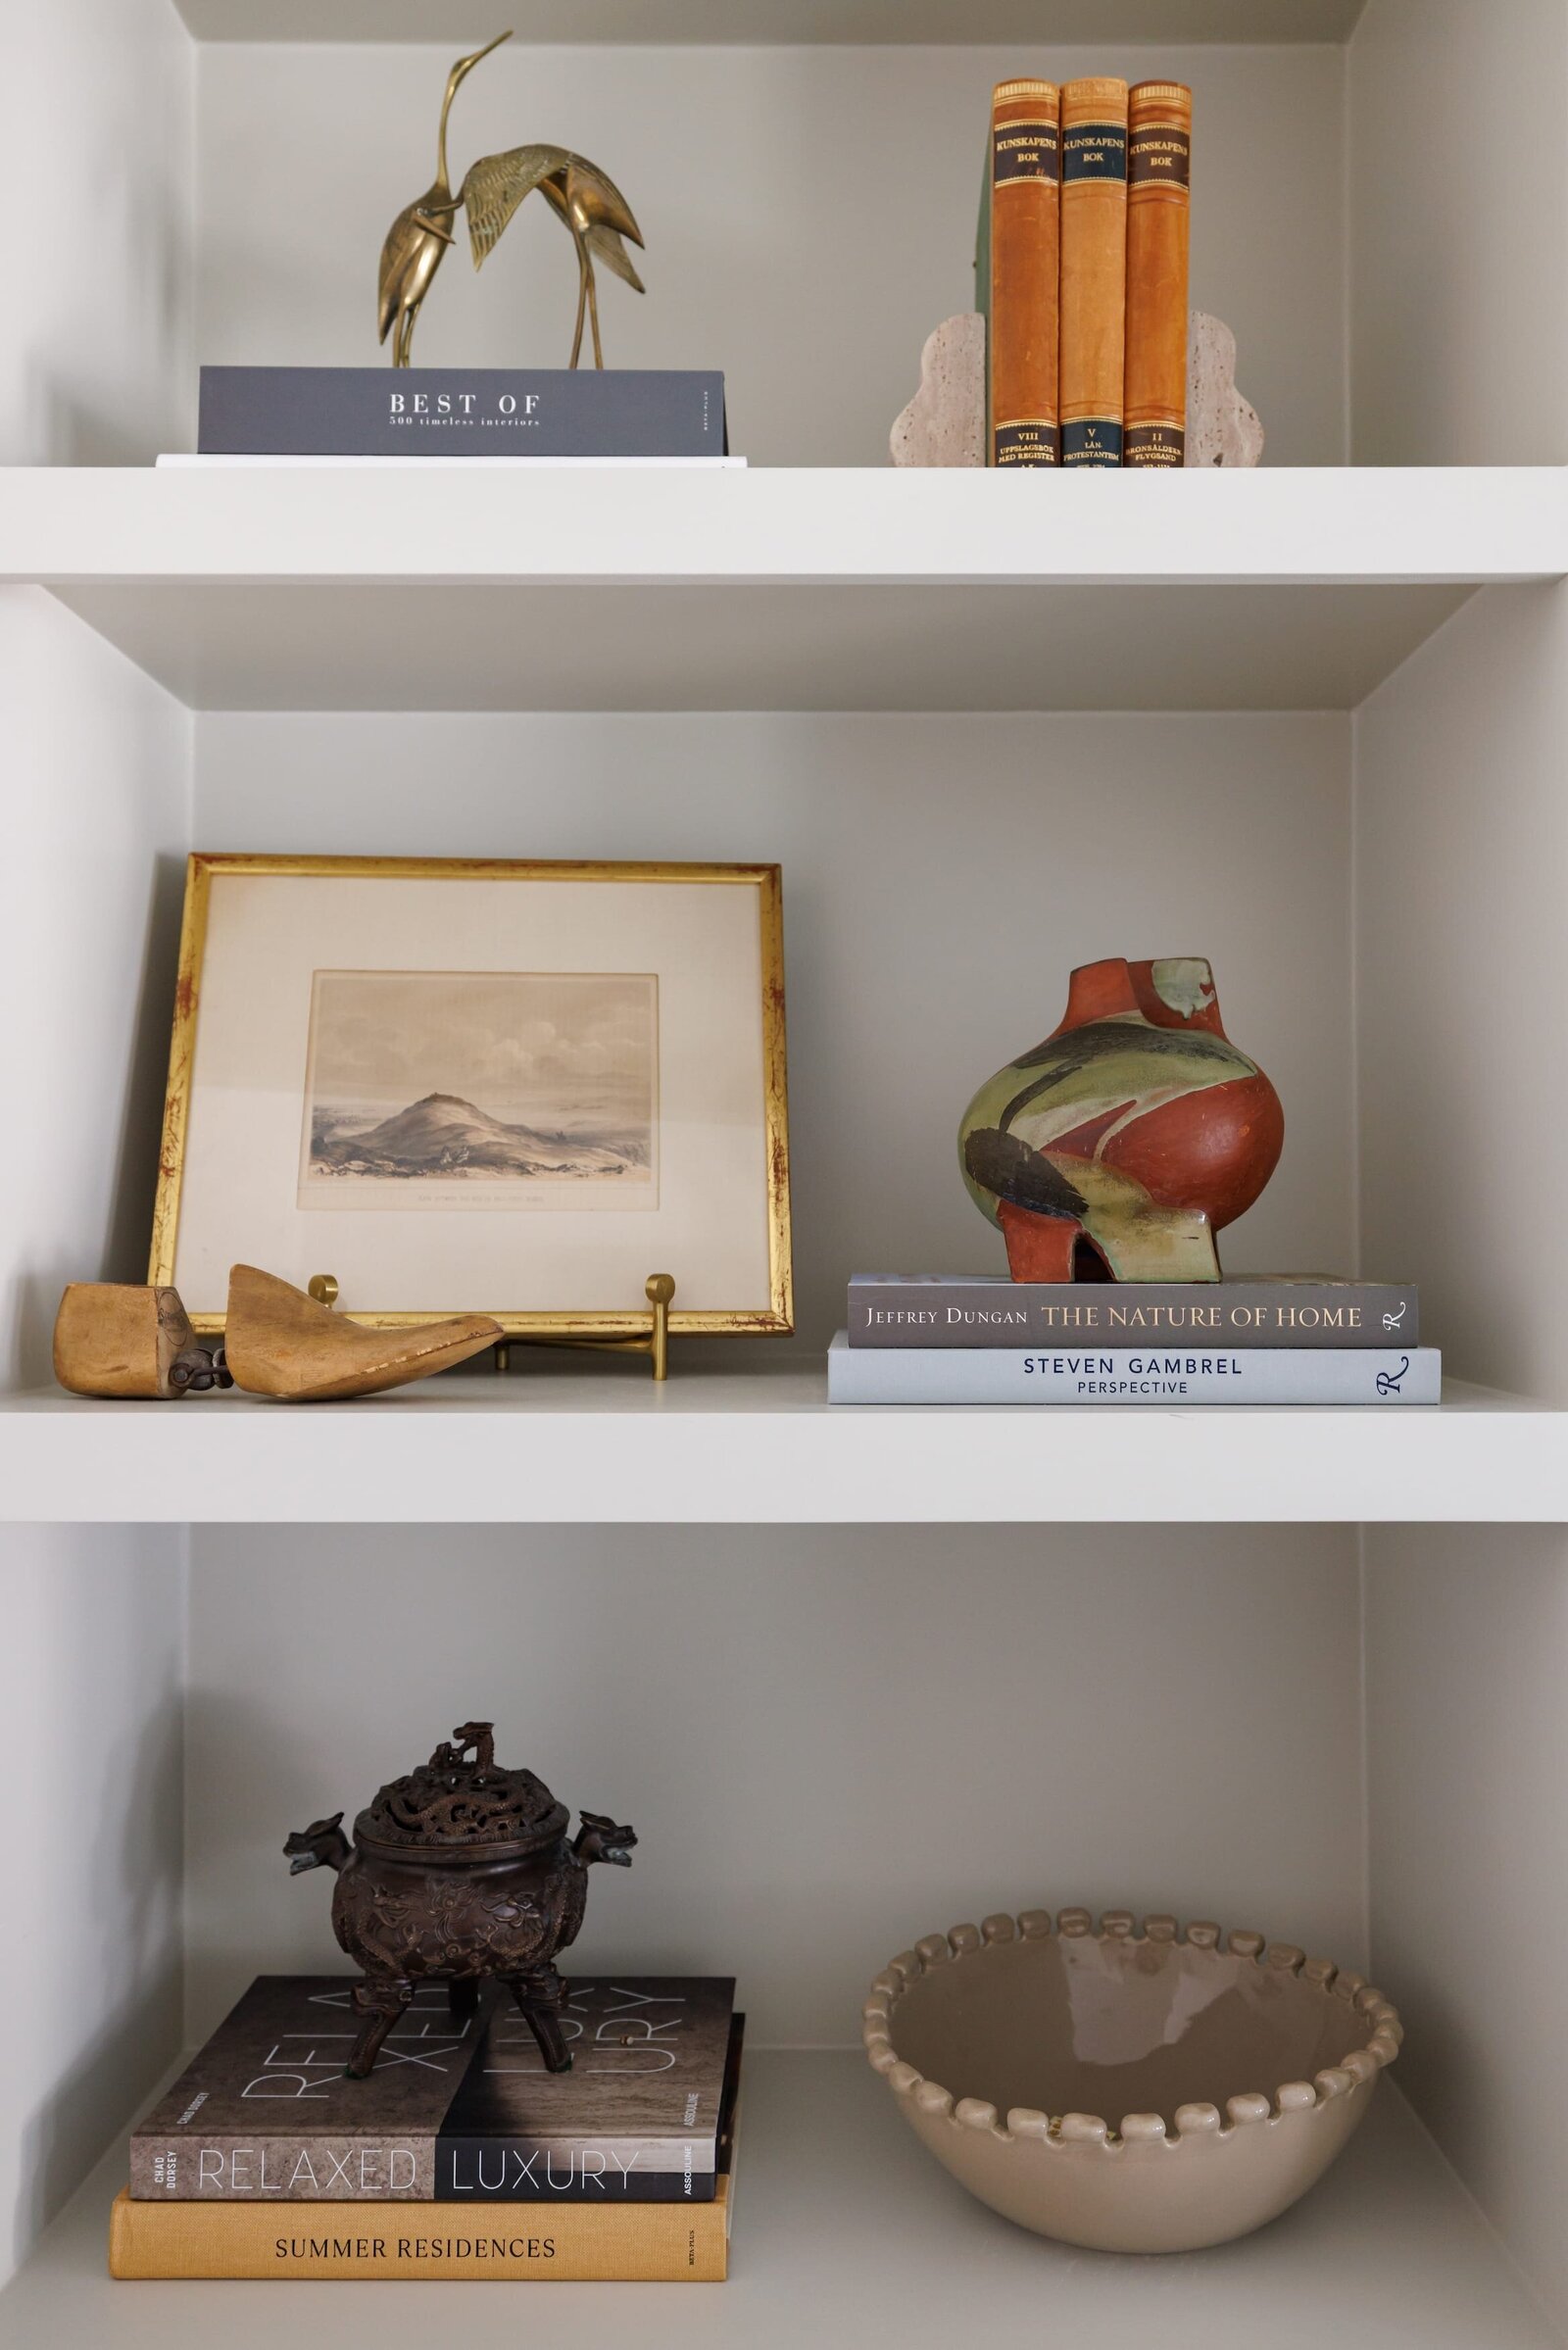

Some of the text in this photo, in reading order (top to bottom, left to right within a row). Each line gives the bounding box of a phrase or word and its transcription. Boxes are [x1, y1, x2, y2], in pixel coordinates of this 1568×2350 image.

[997, 137, 1057, 152] KUNSKAPENS
[1063, 137, 1125, 151] KUNSKAPENS
[1130, 141, 1188, 156] KUNSKAPENS
[1017, 153, 1039, 163] BOK
[1083, 153, 1103, 163] BOK
[1151, 157, 1172, 167] BOK
[390, 394, 540, 415] BEST OF
[389, 416, 540, 426] 500 timeless interiors
[1017, 432, 1039, 441] VIII
[1087, 428, 1096, 437] V
[1152, 432, 1163, 441] II
[1000, 444, 1054, 455] UPPSLAGSBOK
[999, 452, 1055, 464] MED REGISTER
[1135, 452, 1177, 463] FLYGSAND
[866, 1307, 1027, 1327] JEFFREY DUNGAN
[1041, 1306, 1362, 1327] THE NATURE OF HOME
[1024, 1358, 1242, 1374] STEVEN GAMBREL
[1078, 1382, 1188, 1394] PERSPECTIVE
[586, 1987, 685, 2073] URY
[154, 2157, 165, 2183] CHAD
[166, 2150, 176, 2188] DORSEY
[199, 2149, 640, 2189] RELAXED LUXURY
[275, 2238, 556, 2259] SUMMER RESIDENCES
